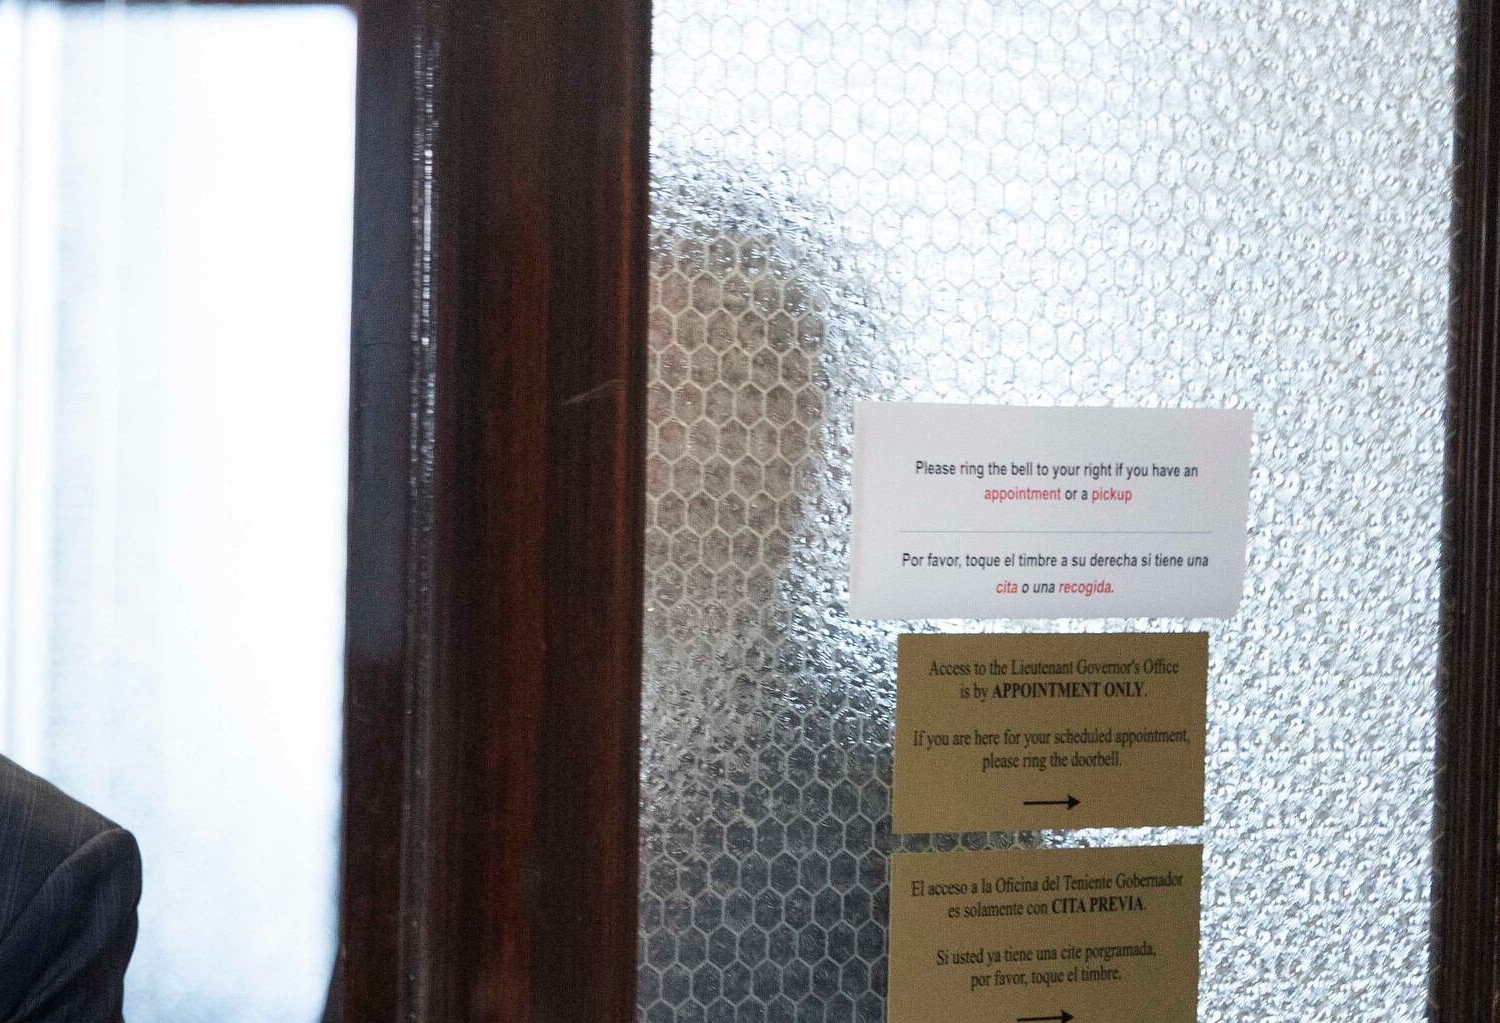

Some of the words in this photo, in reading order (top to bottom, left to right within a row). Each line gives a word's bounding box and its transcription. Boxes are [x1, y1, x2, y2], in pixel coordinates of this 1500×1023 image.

[916, 461, 956, 475] Please
[960, 462, 984, 480] ring
[988, 463, 1007, 476] the
[1012, 462, 1032, 476] bell
[1037, 463, 1048, 476] to
[1053, 465, 1080, 480] your
[1084, 462, 1111, 480] right
[1115, 463, 1123, 477] if
[1126, 465, 1148, 481] you
[1152, 463, 1180, 477] have
[1184, 466, 1198, 477] an
[984, 487, 1061, 503] appointment
[1065, 488, 1077, 500] or
[1081, 488, 1088, 500] a
[1092, 487, 1132, 504] pickup
[902, 553, 923, 567] Por
[927, 553, 962, 570] favor,
[966, 554, 1000, 571] toque
[1004, 553, 1015, 567] el
[1018, 553, 1057, 567] timbre
[1061, 556, 1068, 567] a
[1071, 556, 1086, 567] su
[1090, 553, 1137, 567] derecha
[1141, 553, 1151, 567] si
[1155, 553, 1183, 567] tiene
[1187, 556, 1208, 567] una
[996, 580, 1017, 594] cita
[1022, 583, 1028, 594] o
[1033, 583, 1055, 594] una
[1059, 580, 1114, 597] recogida.
[929, 662, 971, 676] Access
[974, 663, 986, 675] to
[989, 660, 1006, 675] the
[1012, 660, 1073, 675] Lieutenant
[1144, 658, 1179, 674] Office
[960, 683, 971, 699] is
[974, 683, 989, 702] by
[993, 682, 1100, 699] APPOINTMENT
[913, 730, 925, 746] If
[927, 734, 949, 750] you
[953, 734, 971, 745] are
[974, 730, 999, 745] here
[1004, 730, 1021, 745] for
[1024, 733, 1051, 749] your
[1054, 729, 1112, 743] scheduled
[982, 753, 1019, 772] please
[1023, 756, 1047, 771] ring
[1050, 754, 1068, 768] the
[912, 880, 924, 897] El
[928, 883, 968, 896] acceso
[971, 883, 977, 894] a
[982, 879, 992, 894] la
[996, 877, 1038, 893] Oficina
[1042, 876, 1059, 891] del
[1064, 875, 1112, 891] Teniente
[1116, 872, 1183, 889] Gobernador
[948, 906, 960, 918] es
[964, 902, 1024, 917] solamente
[1027, 903, 1048, 914] con
[1052, 898, 1086, 913] CITA
[937, 949, 949, 965] Si
[953, 948, 984, 965] usted
[987, 952, 1000, 967] ya
[1004, 946, 1033, 962] tiene
[1036, 949, 1057, 961] una
[971, 973, 992, 991] por
[994, 971, 1028, 987] favor,
[1032, 970, 1064, 987] toque
[1067, 966, 1078, 982] el
